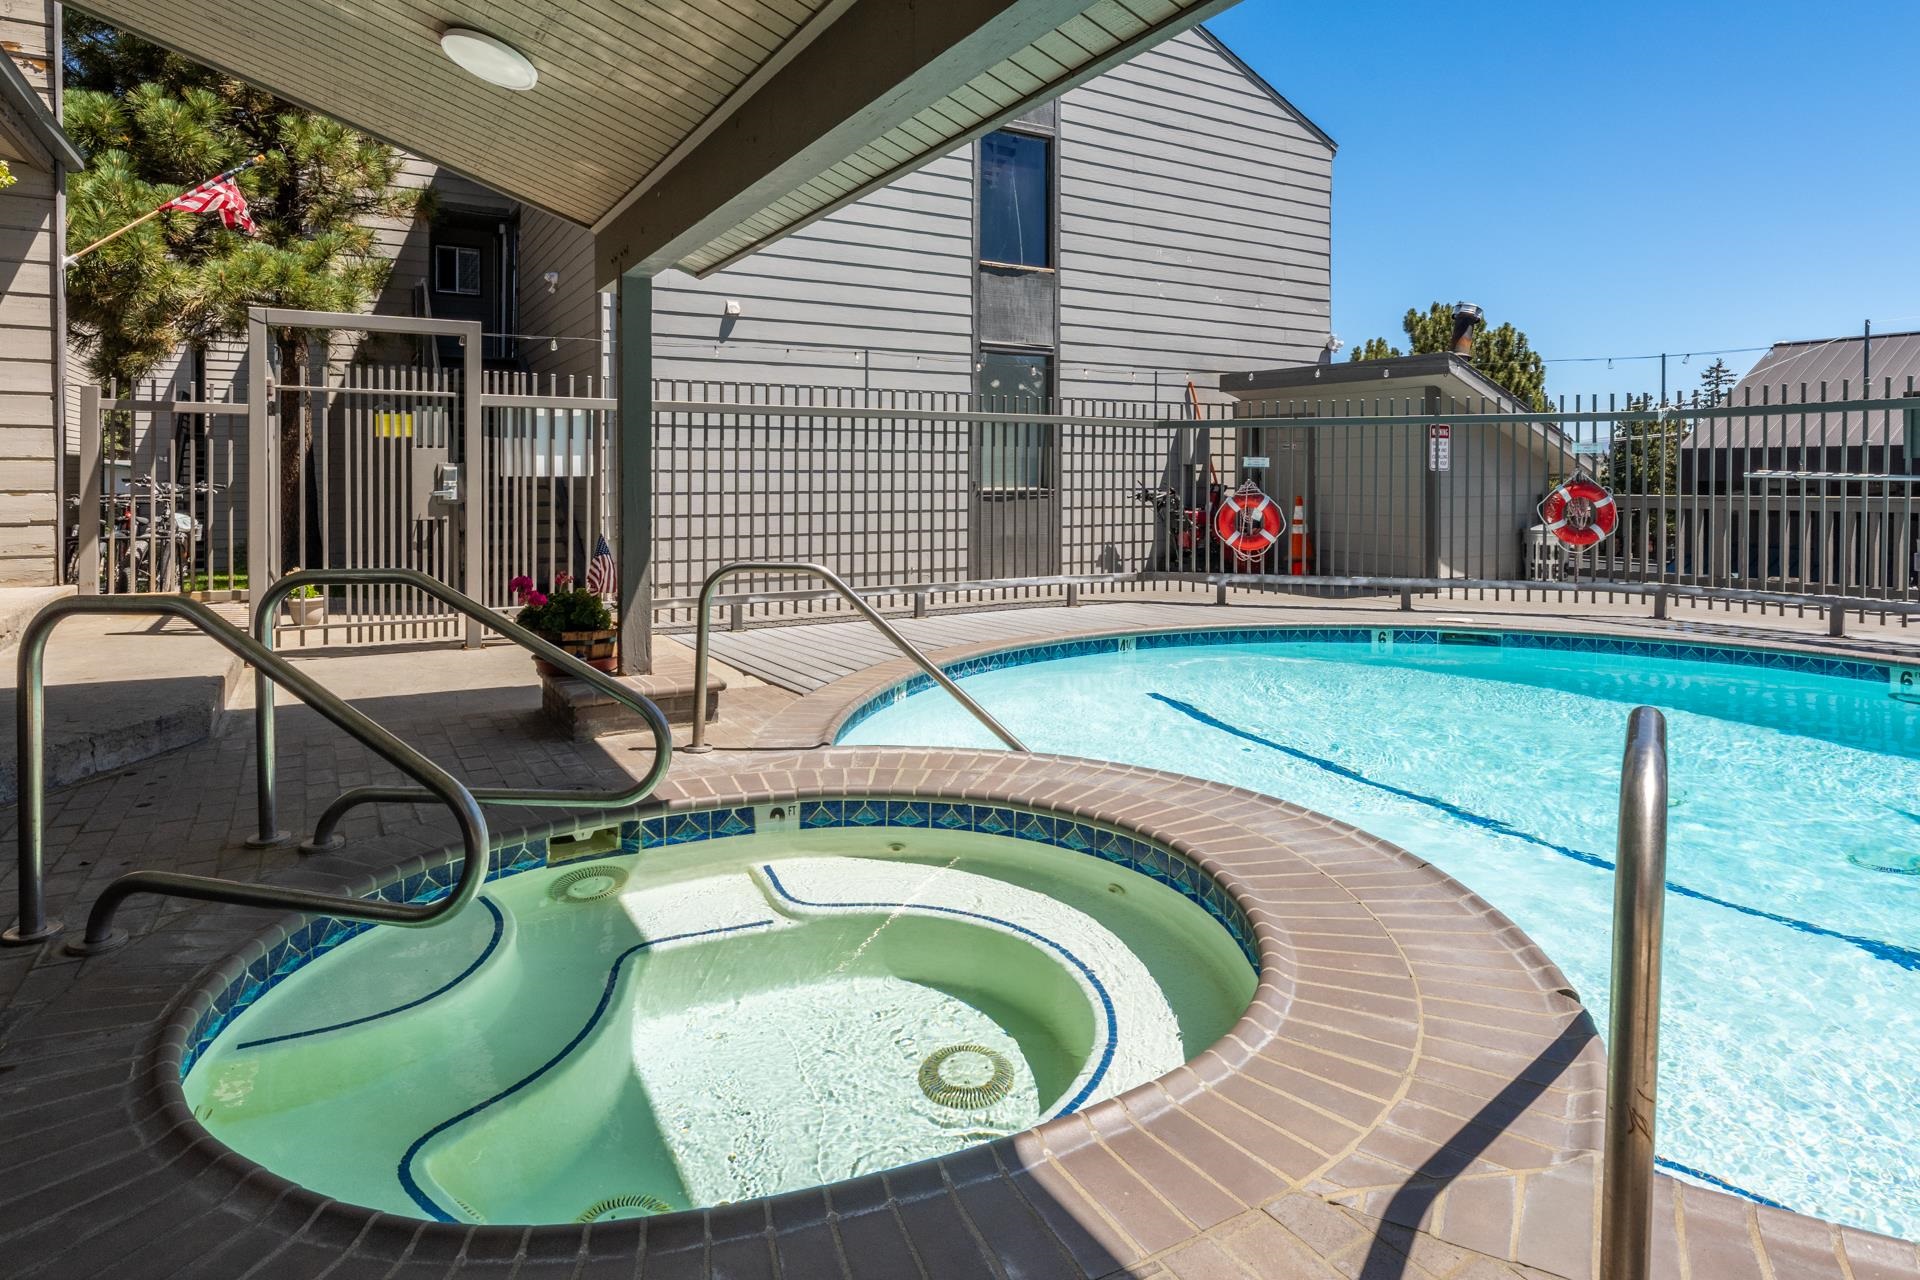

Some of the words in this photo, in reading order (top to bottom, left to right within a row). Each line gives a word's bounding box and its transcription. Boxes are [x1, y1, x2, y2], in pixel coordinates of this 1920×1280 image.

[1378, 631, 1387, 643] 6
[1900, 671, 1913, 686] 6
[788, 805, 797, 816] FT
